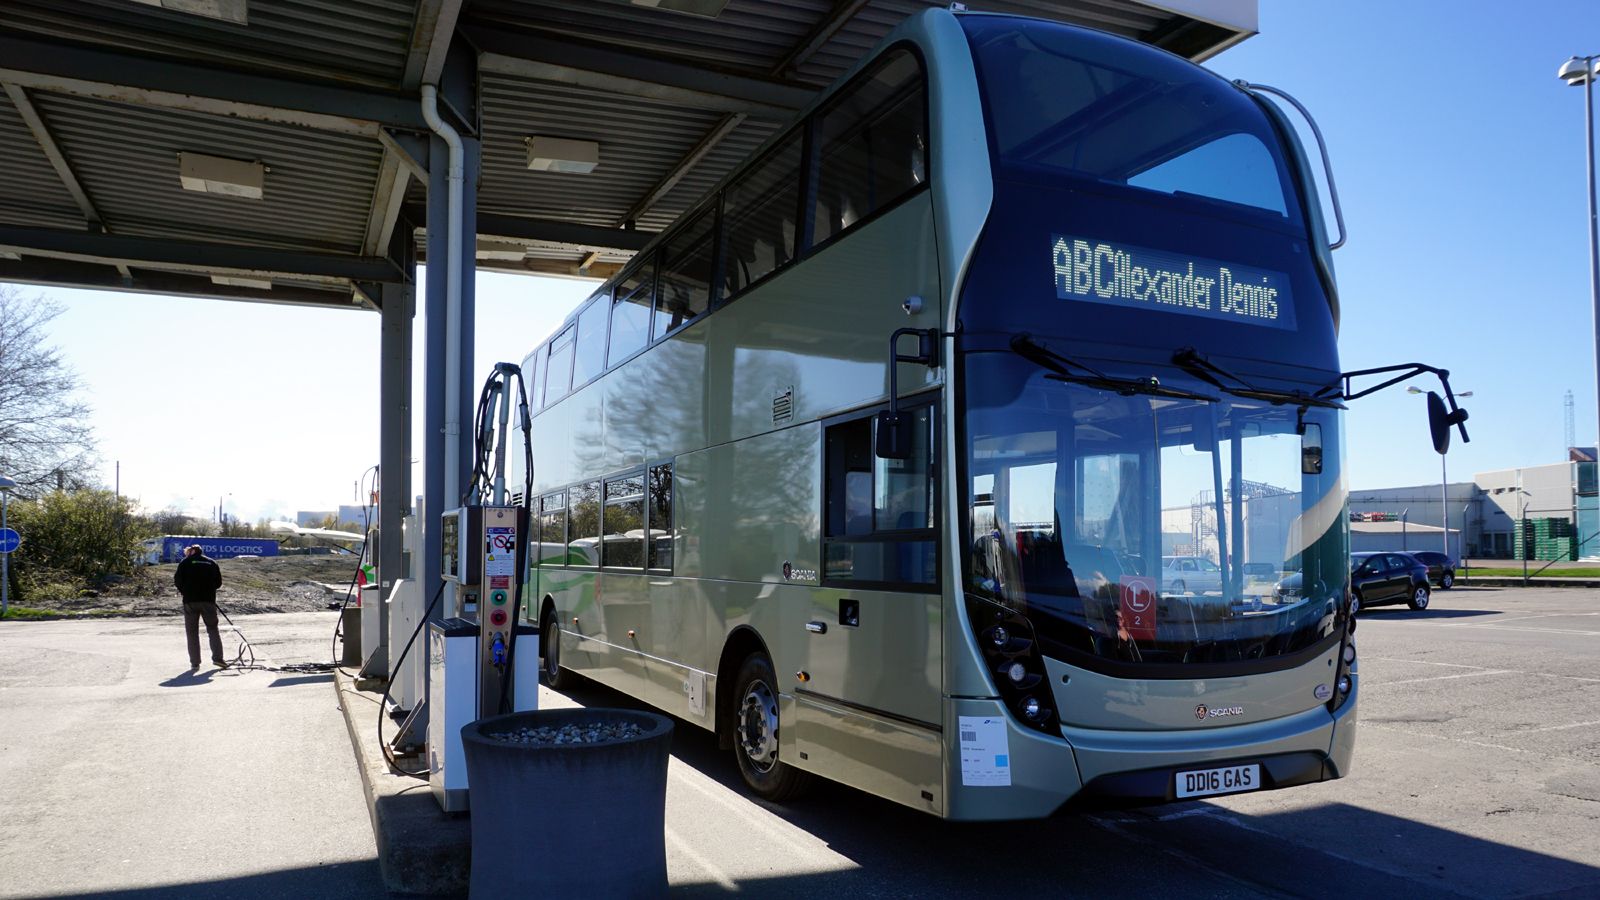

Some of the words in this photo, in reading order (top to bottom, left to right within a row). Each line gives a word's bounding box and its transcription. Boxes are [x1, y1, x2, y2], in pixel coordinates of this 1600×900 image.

[1053, 237, 1114, 298] ABC
[1114, 249, 1215, 310] Alexander
[1220, 267, 1278, 319] Dennis
[220, 545, 263, 554] LOGISTICS
[791, 569, 816, 581] SCANIA
[1135, 616, 1141, 625] 2
[1209, 706, 1244, 718] SCANIA
[1186, 771, 1219, 792] DD16
[1224, 767, 1251, 788] GAS
